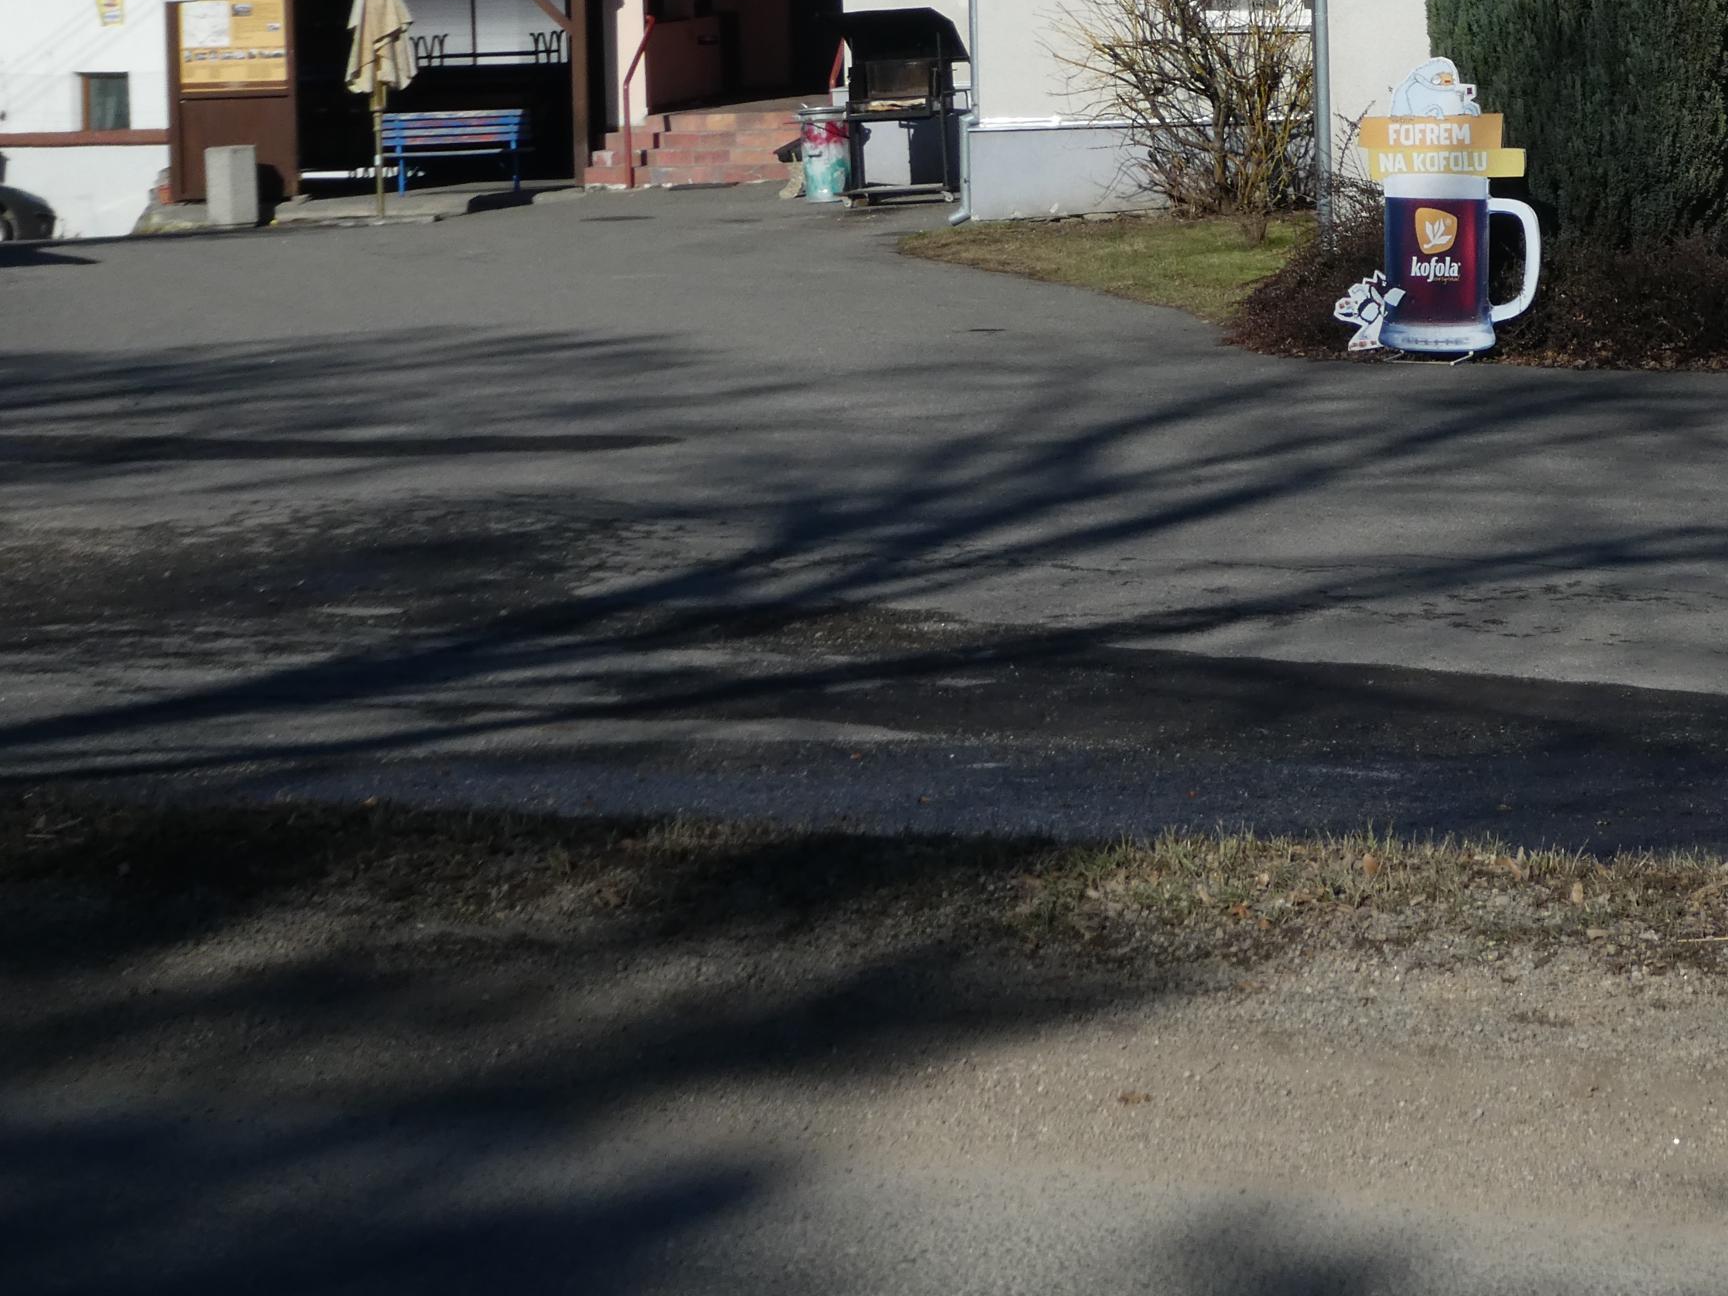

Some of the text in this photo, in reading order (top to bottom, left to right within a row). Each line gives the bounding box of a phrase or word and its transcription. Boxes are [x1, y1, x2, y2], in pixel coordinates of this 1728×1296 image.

[1387, 123, 1471, 146] FOFREM
[1378, 150, 1488, 173] NA KOFOLU
[1410, 256, 1460, 283] kofola
